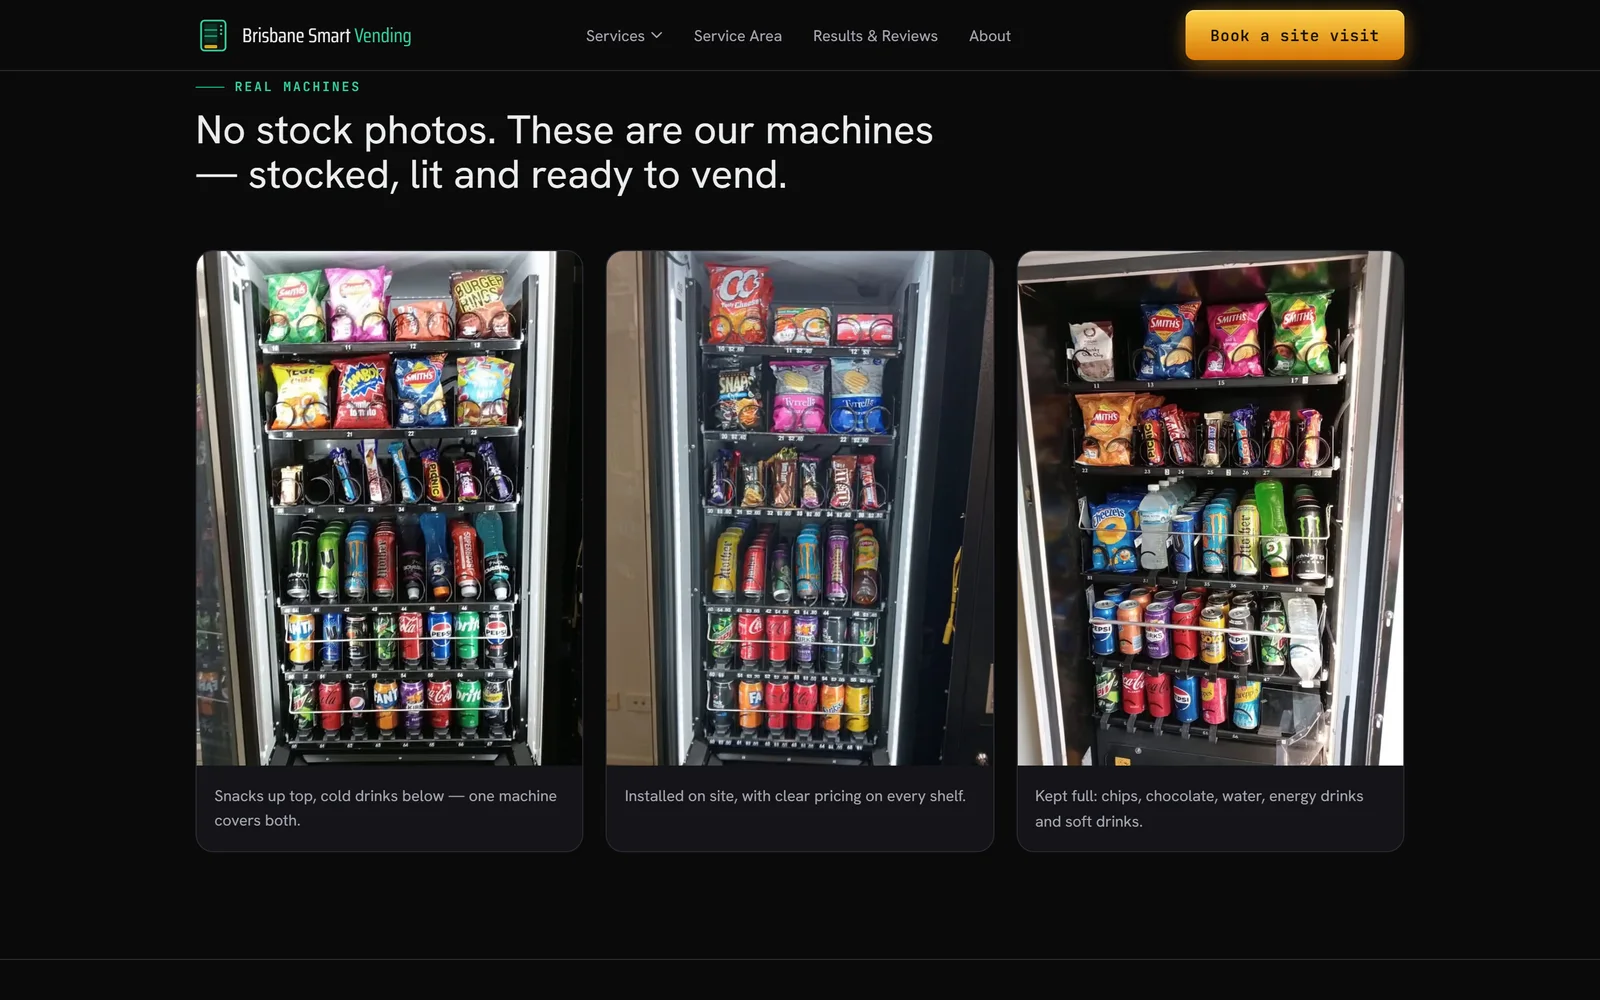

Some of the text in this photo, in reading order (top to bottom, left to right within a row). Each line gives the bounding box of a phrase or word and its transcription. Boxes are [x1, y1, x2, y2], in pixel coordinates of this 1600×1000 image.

[242, 26, 412, 48] Brisbane Smart Vending
[585, 29, 646, 43] Services
[693, 29, 783, 43] Service Area
[813, 29, 939, 43] Results & Reviews
[968, 29, 1012, 43] About
[1209, 28, 1380, 43] Book a site visit
[234, 80, 361, 93] REAL MACHINES
[196, 114, 934, 153] No stock photos. These are our machines
[248, 158, 399, 195] stocked,
[411, 158, 443, 190] lit
[454, 158, 519, 190] and
[532, 158, 634, 197] ready
[643, 160, 680, 190] to
[690, 158, 786, 190] vend.
[1150, 316, 1181, 330] SMITH'S
[1215, 311, 1248, 326] SMITH'S
[1282, 310, 1315, 326] SMITH'S
[1093, 411, 1119, 421] MITH'S
[373, 687, 398, 705] FANT
[214, 789, 264, 803] Snacks
[267, 792, 286, 806] up
[288, 790, 317, 806] top,
[320, 789, 351, 803] cold
[354, 789, 399, 803] drinks
[402, 789, 445, 803] below
[468, 792, 495, 803] one
[499, 789, 558, 803] machine
[625, 789, 967, 807] Installed on site, with clear pricing on every shelf.
[1035, 789, 1364, 807] Kept full: chips, chocolate, water, energy drinks
[214, 813, 301, 828] covers both.
[1035, 814, 1143, 828] and soft drinks.
